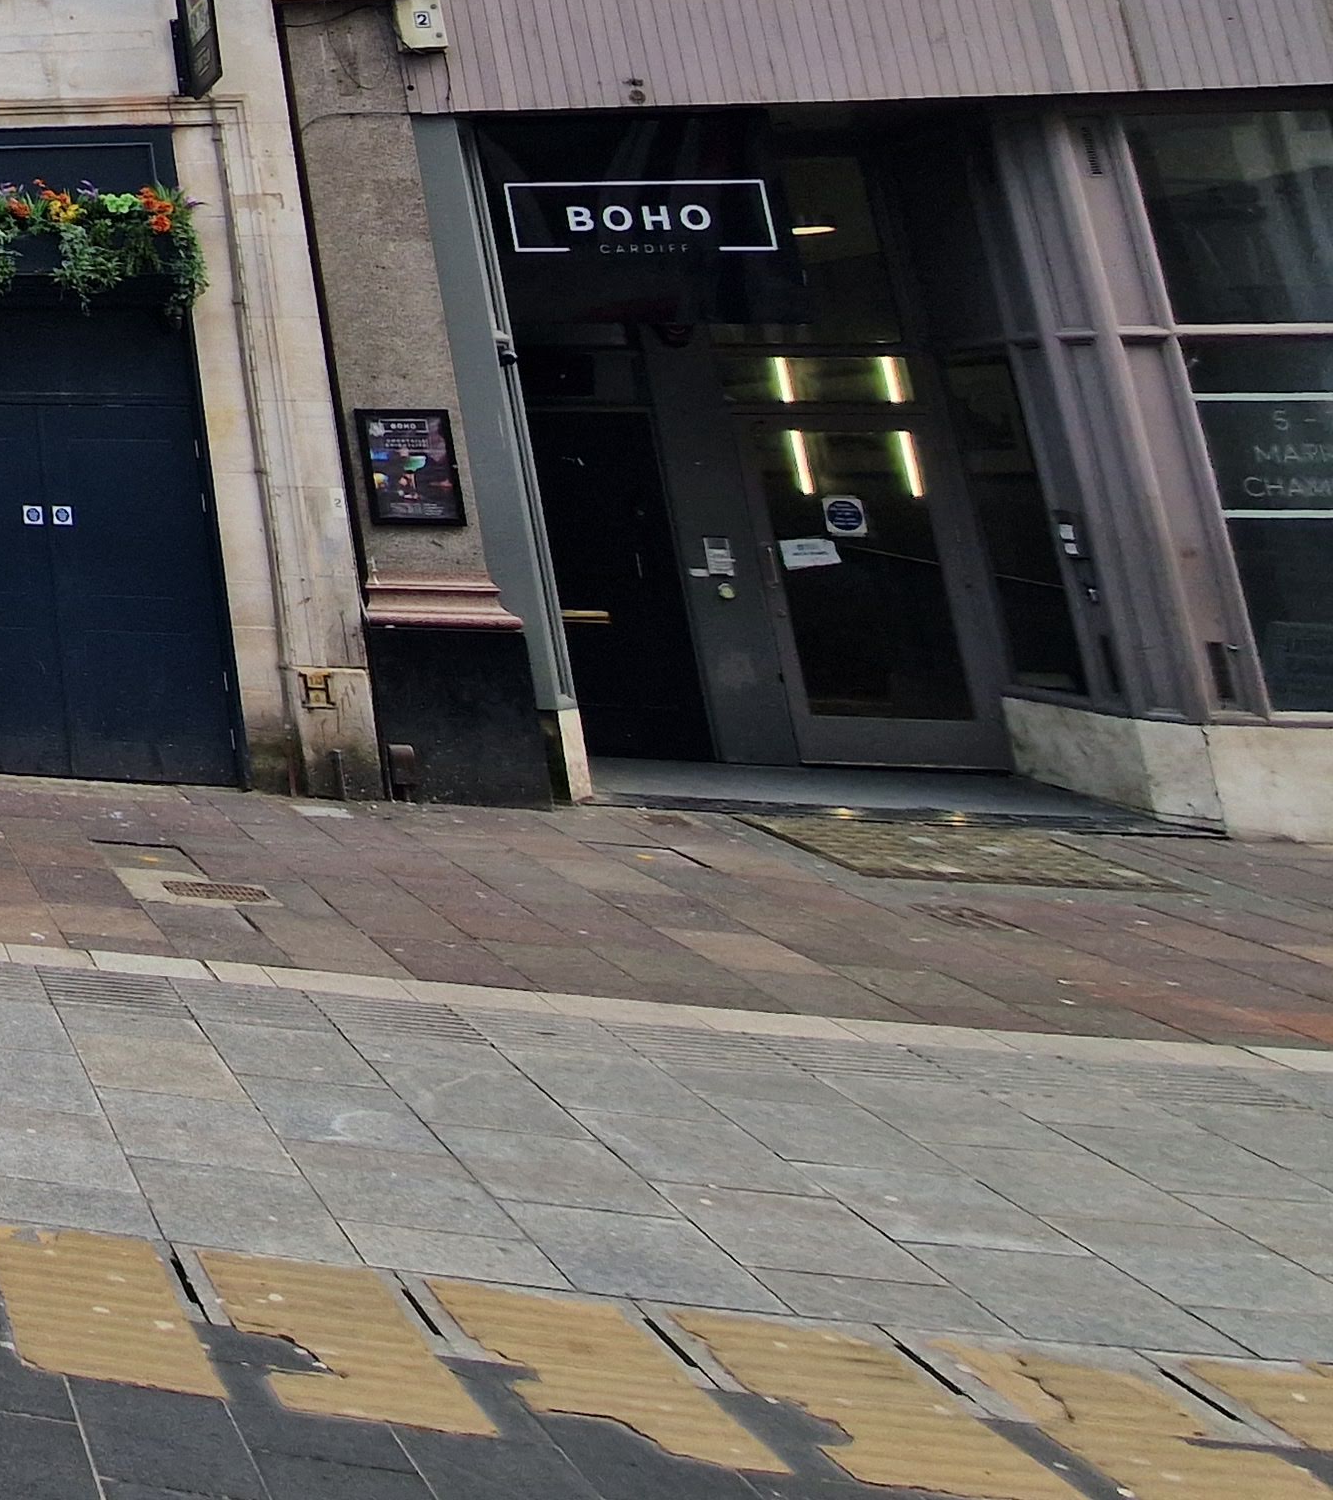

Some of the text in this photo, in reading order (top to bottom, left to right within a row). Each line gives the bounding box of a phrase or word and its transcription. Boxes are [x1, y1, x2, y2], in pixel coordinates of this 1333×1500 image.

[417, 14, 428, 26] 2
[566, 204, 712, 232] BOHO
[599, 243, 689, 255] CARDIFF
[390, 422, 416, 431] BOHO
[1274, 410, 1289, 431] 5
[333, 498, 342, 508] 2
